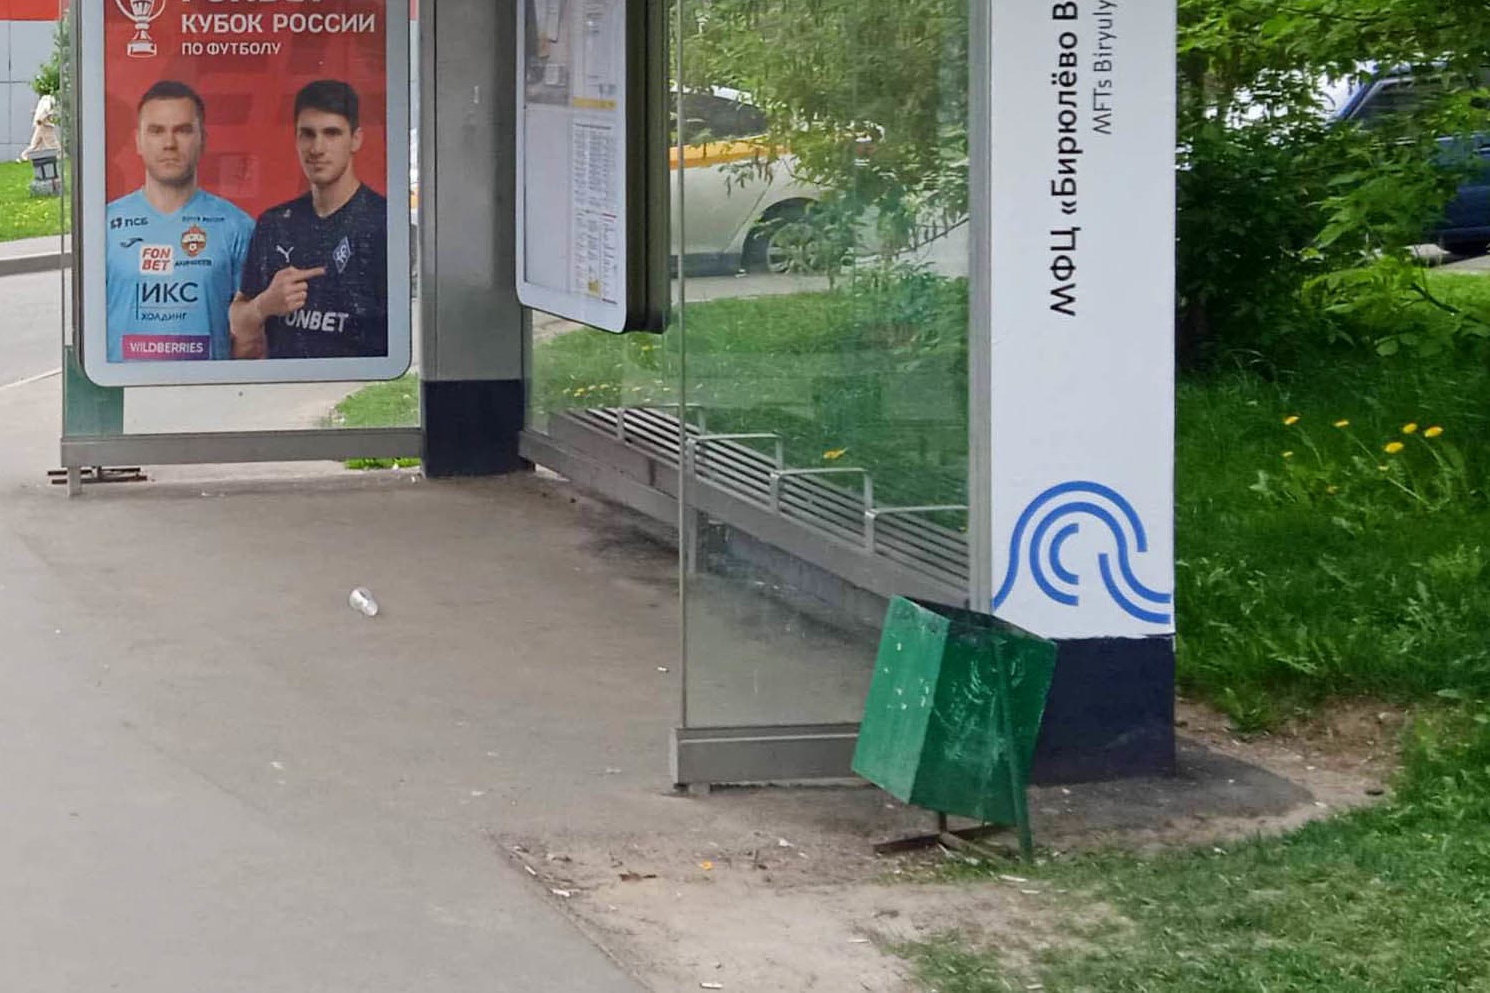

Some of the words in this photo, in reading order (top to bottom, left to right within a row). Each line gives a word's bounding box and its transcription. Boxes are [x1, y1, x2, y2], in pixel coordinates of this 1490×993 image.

[181, 13, 263, 34] КУБОК
[272, 13, 375, 34] РОССИИ
[182, 43, 203, 56] ПО
[206, 42, 281, 56] ФУТБОЛУ
[1092, 77, 1113, 135] MFTs
[1051, 31, 1083, 216] «Бирюлёво
[142, 247, 171, 259] FON
[142, 259, 171, 271] BET
[1049, 225, 1081, 317] МФЦ
[141, 282, 199, 303] ИКС
[286, 309, 350, 333] ONBET
[129, 342, 204, 354] WILDBERRIES
